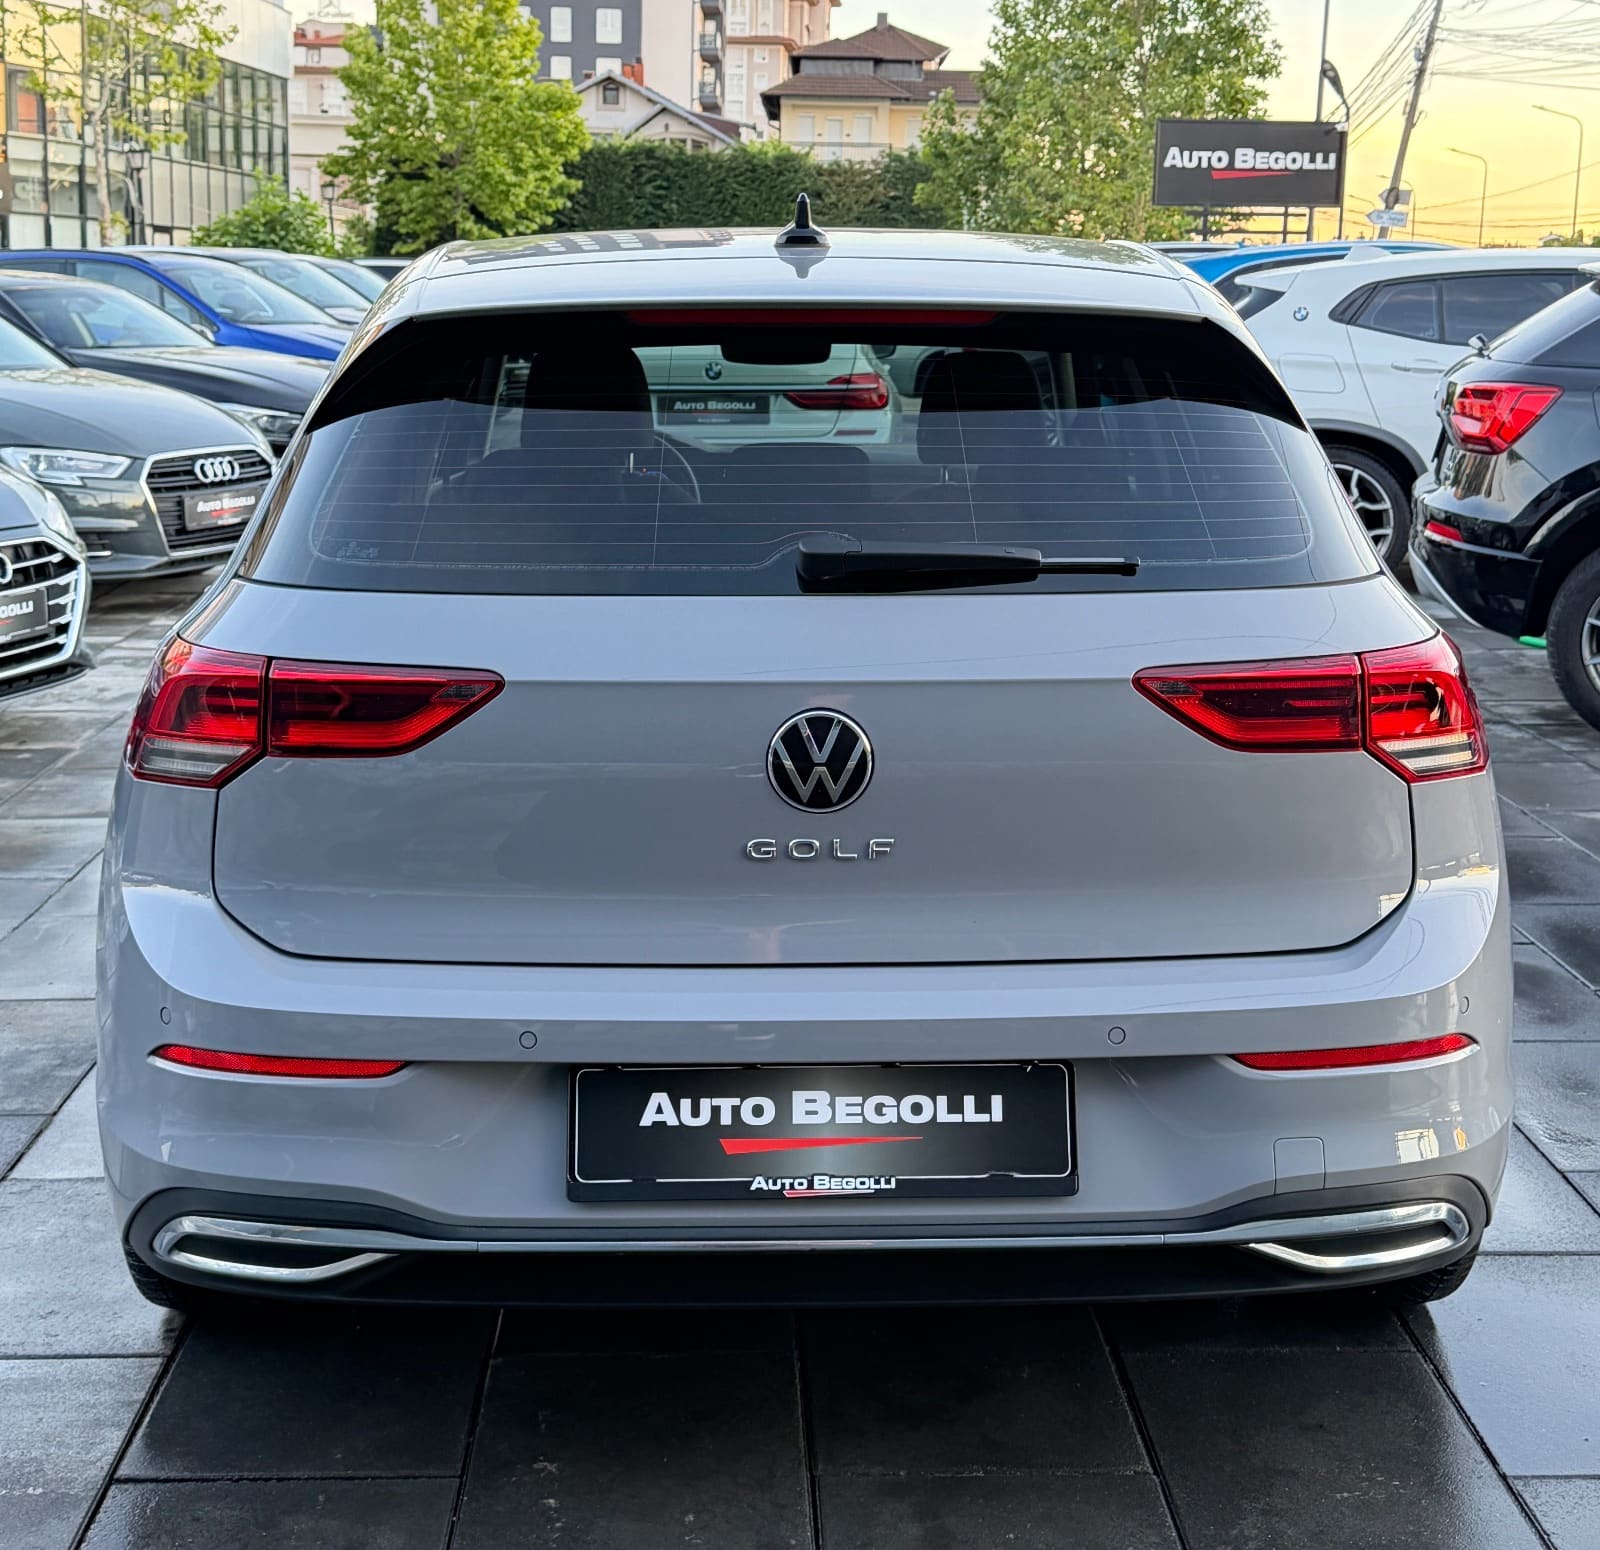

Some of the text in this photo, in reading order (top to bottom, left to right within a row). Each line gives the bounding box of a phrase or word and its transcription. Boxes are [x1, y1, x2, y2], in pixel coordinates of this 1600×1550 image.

[1163, 146, 1336, 170] AUTO BEGOLLI
[746, 838, 895, 860] GOLF
[639, 1090, 1004, 1127] AUTO BEGOLLI
[750, 1174, 896, 1191] AUTO BEGOLLI
